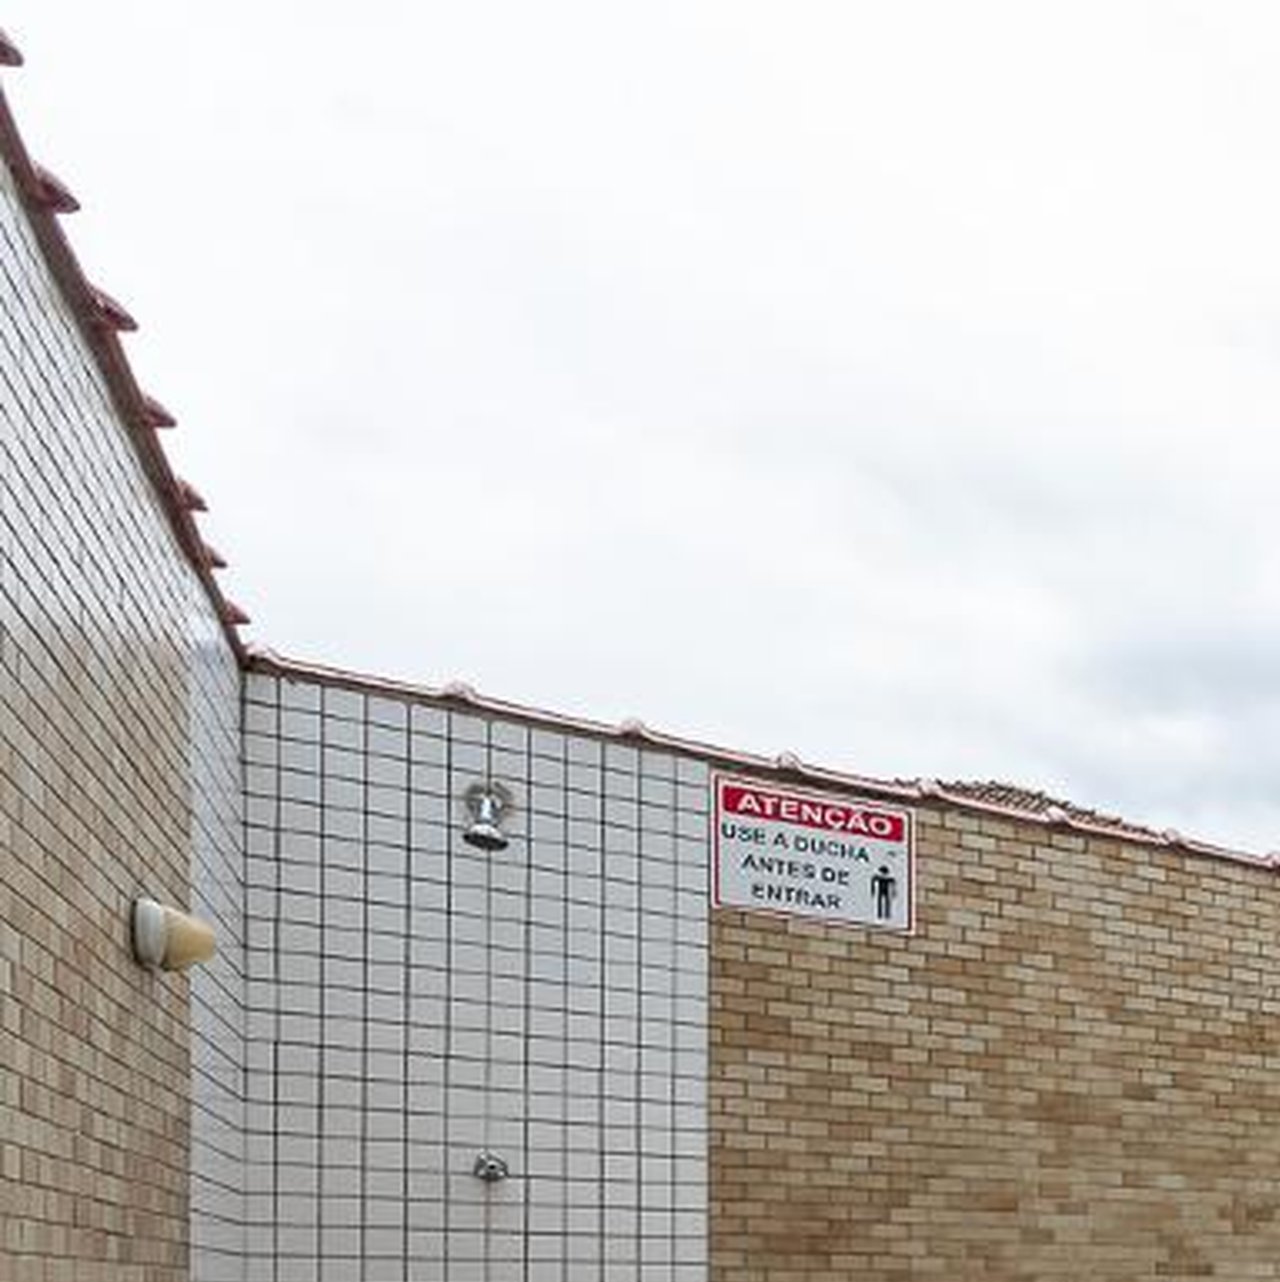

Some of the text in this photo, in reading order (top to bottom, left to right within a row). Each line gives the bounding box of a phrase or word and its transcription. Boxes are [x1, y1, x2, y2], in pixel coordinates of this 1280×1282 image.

[721, 823, 870, 862] USE A DUCHA
[741, 855, 850, 886] ANTES DE
[751, 884, 842, 909] ENTRAR
